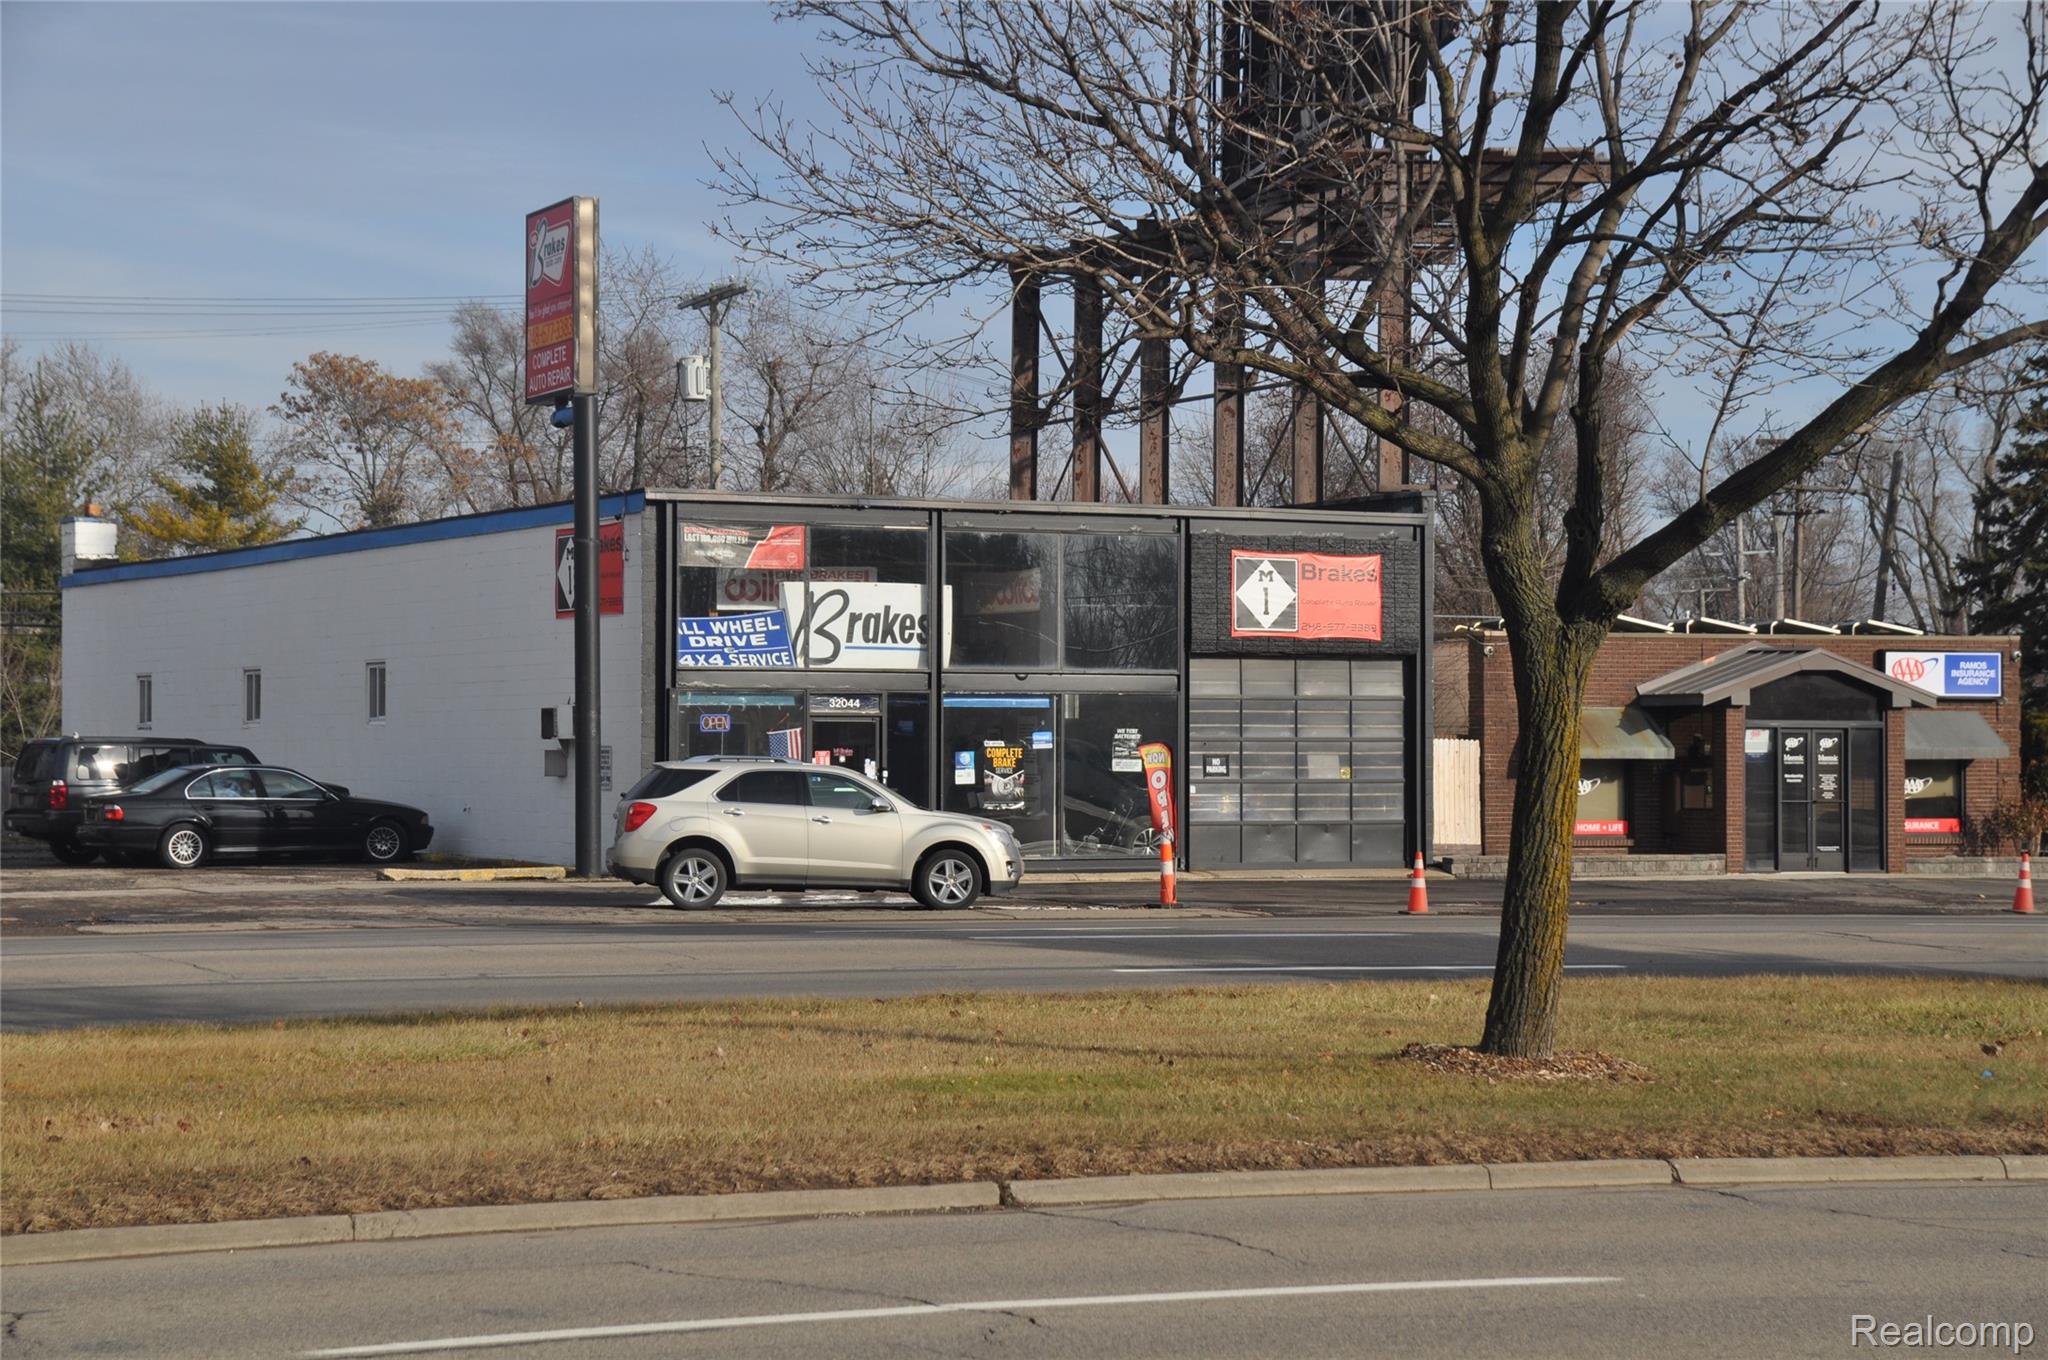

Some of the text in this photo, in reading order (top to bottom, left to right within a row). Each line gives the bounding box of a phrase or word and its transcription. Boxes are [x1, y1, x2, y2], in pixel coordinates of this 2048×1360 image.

[533, 345, 567, 370] COMPLETE
[529, 366, 572, 393] AUTO REPAIR
[811, 570, 863, 580] BRAKES
[1258, 570, 1274, 582] M
[1302, 563, 1377, 582] Brakes
[709, 617, 780, 634] WHEEL
[793, 588, 928, 666] Brakes
[688, 634, 768, 647] DRIVE
[729, 652, 791, 665] SERVICE
[1959, 661, 1987, 669] RAMOS
[829, 698, 860, 708] 32044
[702, 717, 729, 730] OPEN
[986, 747, 1023, 758] COMPLETE
[993, 757, 1016, 768] BRAKE
[1212, 757, 1221, 765] NO
[1206, 765, 1227, 774] PARKING
[1577, 823, 1624, 832] HOME LIFE
[1904, 821, 1939, 830] SURANCE
